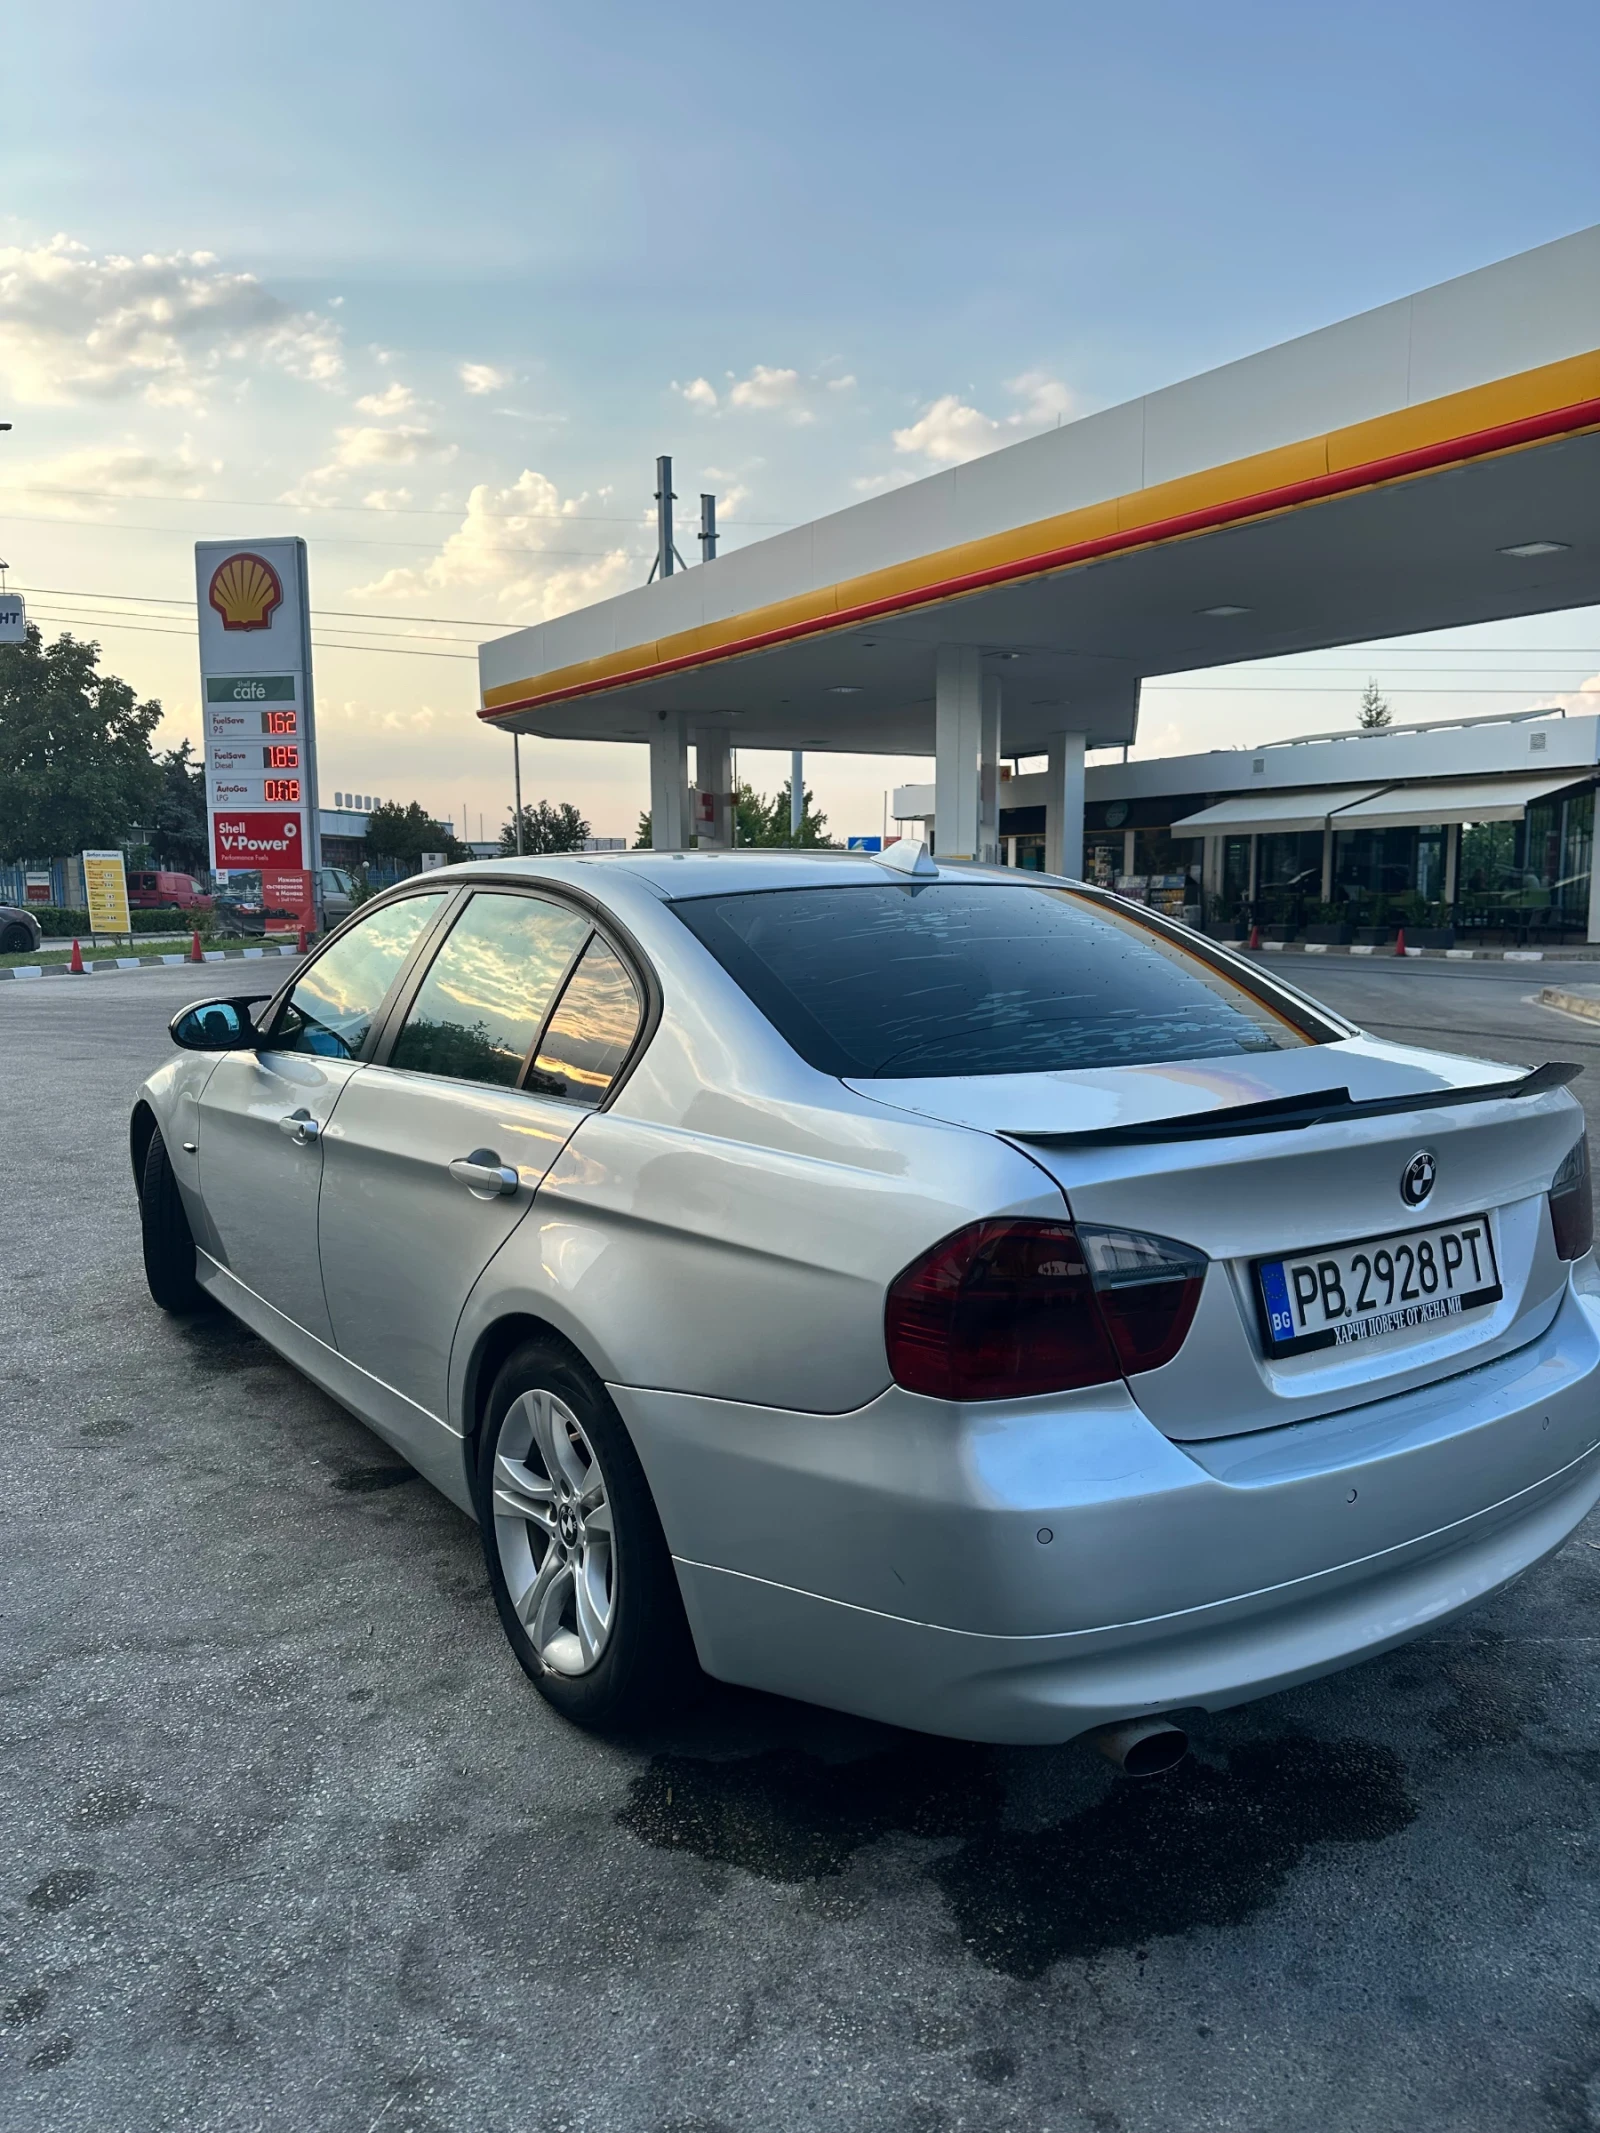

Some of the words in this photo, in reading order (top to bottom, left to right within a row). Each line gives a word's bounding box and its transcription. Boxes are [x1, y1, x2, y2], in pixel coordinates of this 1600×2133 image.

[233, 683, 266, 699] café
[213, 726, 224, 734] 95
[267, 712, 297, 734] 1.62
[214, 752, 246, 760] FuelSave
[268, 746, 298, 767] 1.85
[215, 761, 234, 769] Diesel
[216, 785, 248, 793] AutoGas
[265, 780, 300, 801] 0.68
[219, 822, 246, 834] Shell
[220, 836, 290, 851] V-Power
[1272, 1312, 1291, 1331] BG
[1333, 1321, 1368, 1346] ХАРЧИ
[1368, 1311, 1405, 1337] ПОВЕЧЕ
[1406, 1307, 1419, 1326] ОТ
[1419, 1301, 1447, 1322] ЖЕНА
[1447, 1296, 1463, 1316] МИ
